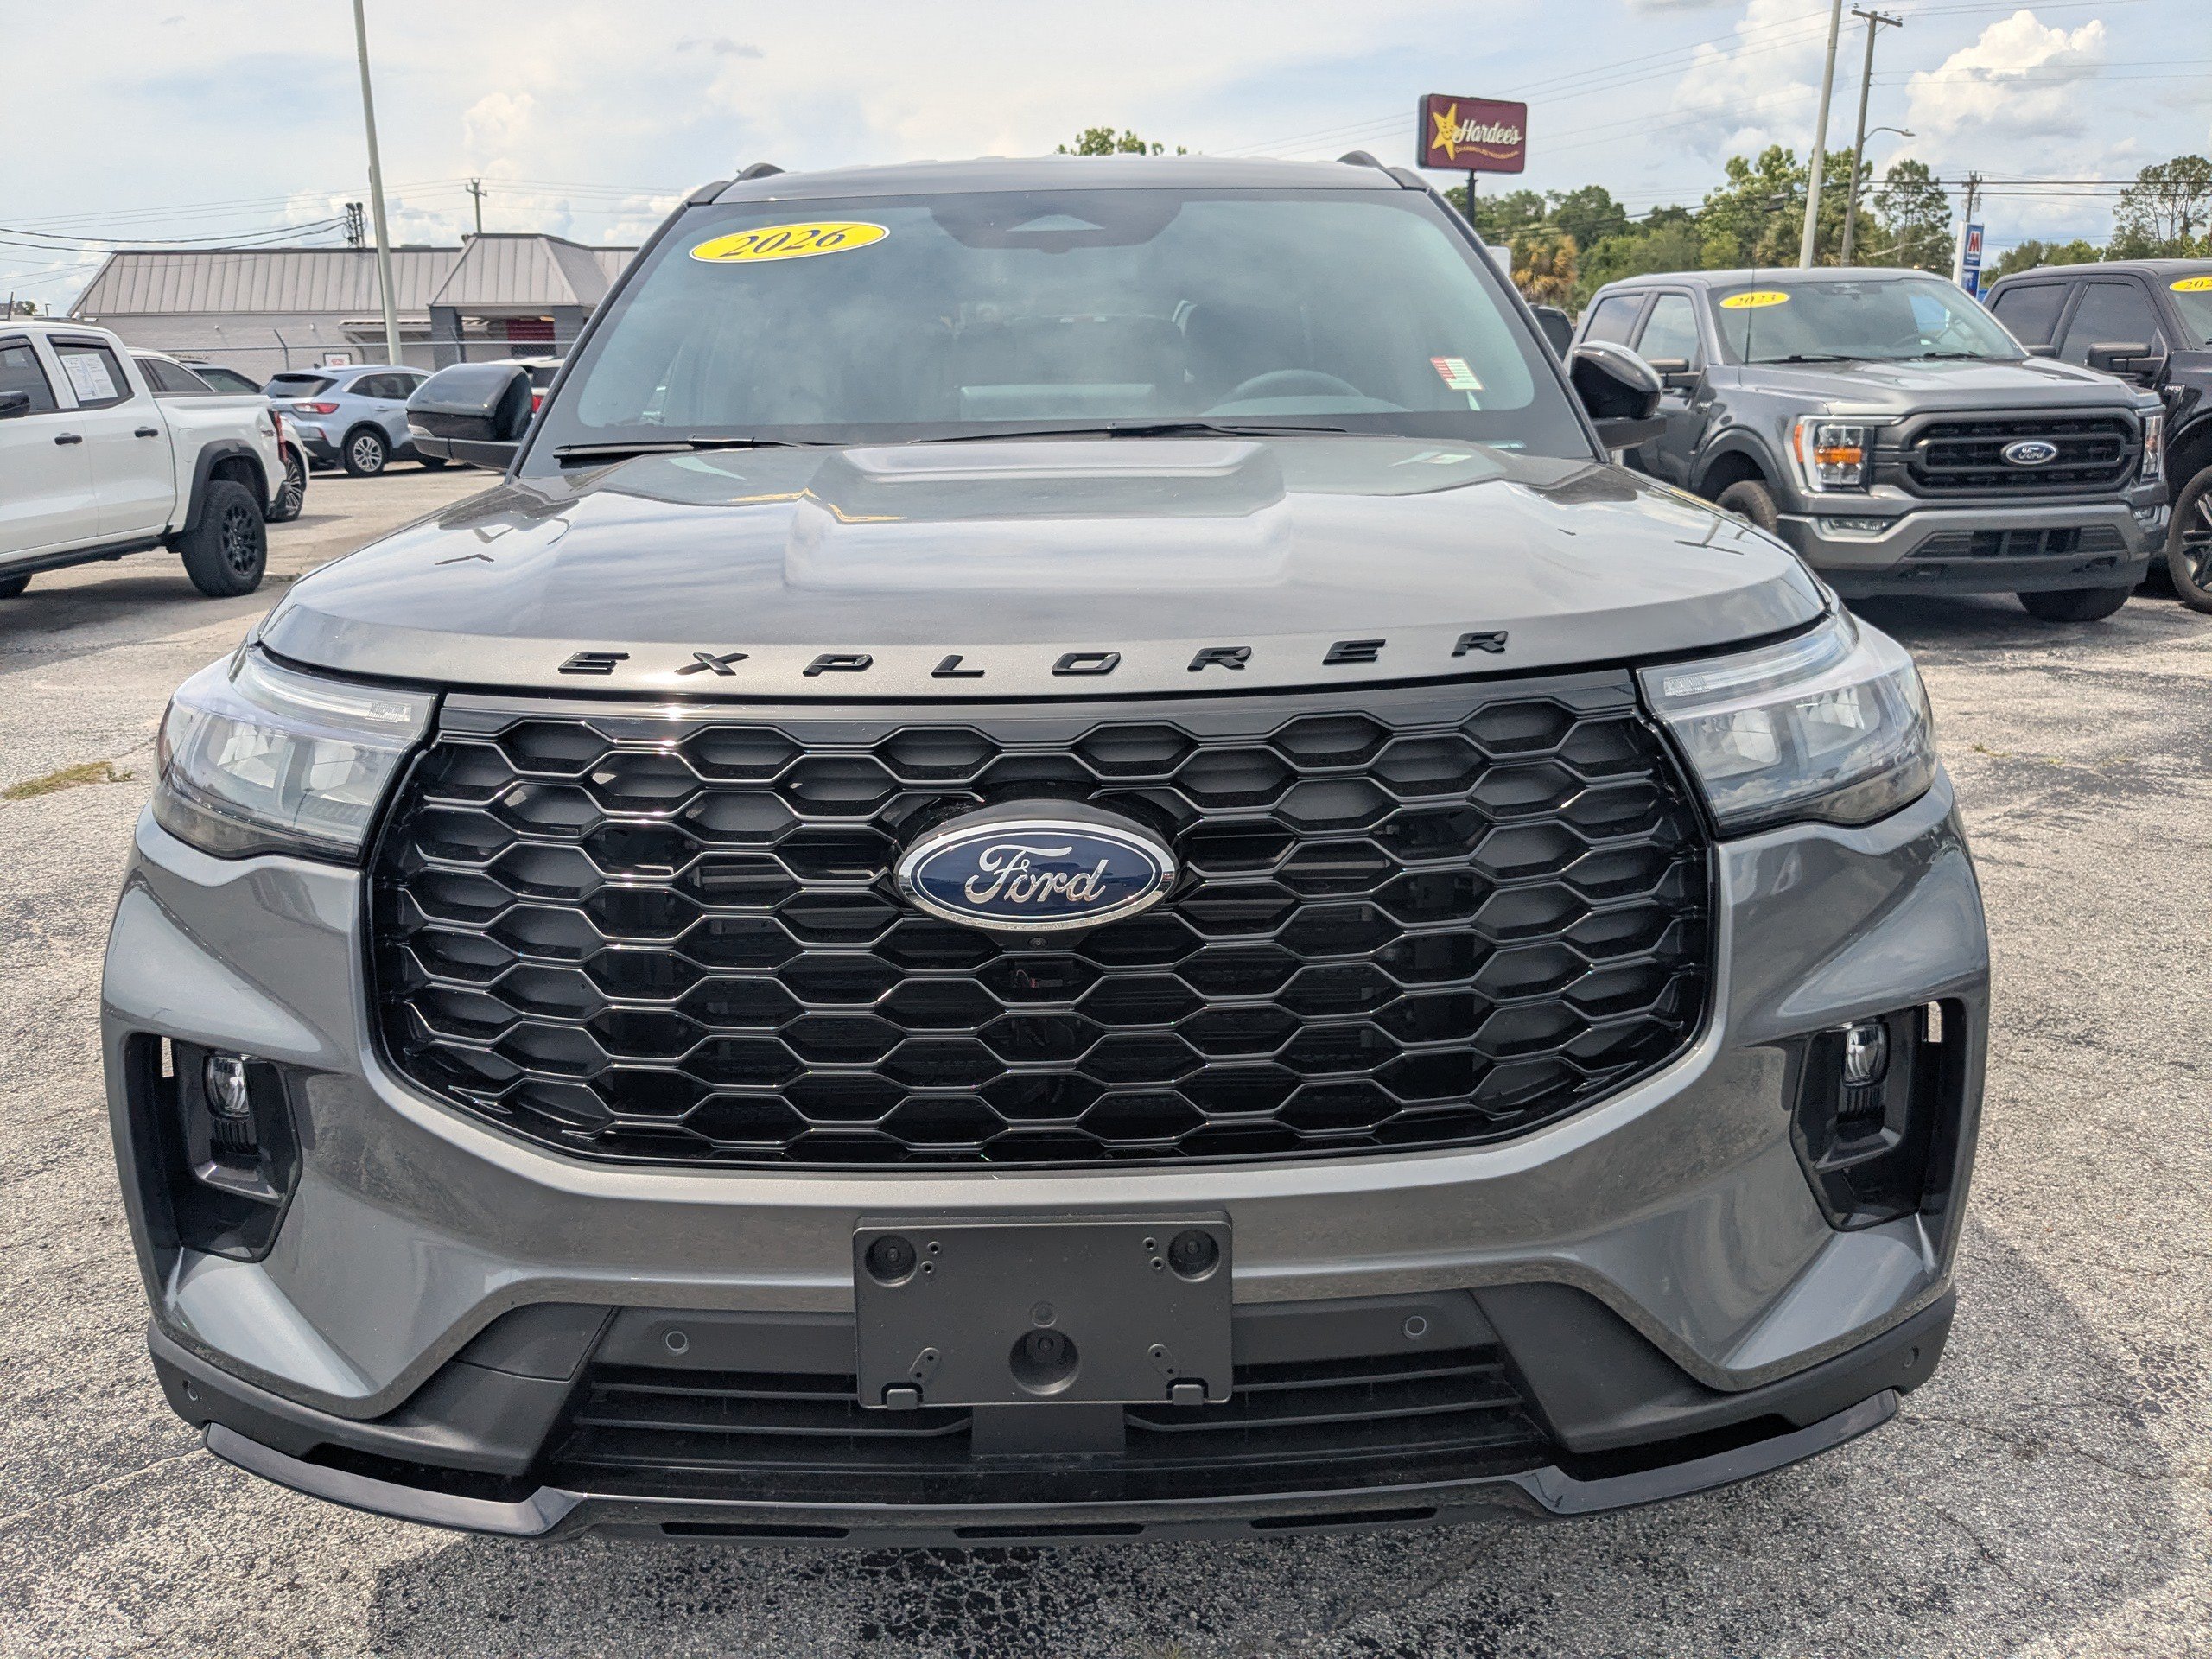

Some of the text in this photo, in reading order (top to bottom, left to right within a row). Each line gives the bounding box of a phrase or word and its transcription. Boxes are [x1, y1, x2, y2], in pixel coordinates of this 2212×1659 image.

[1452, 119, 1523, 145] Hardee's
[716, 226, 860, 258] 2026
[2182, 279, 2212, 290] 202
[1732, 294, 1777, 307] 2023
[2018, 447, 2046, 460] Ford
[557, 630, 1509, 677] EXPLORER
[964, 844, 1109, 904] Ford
